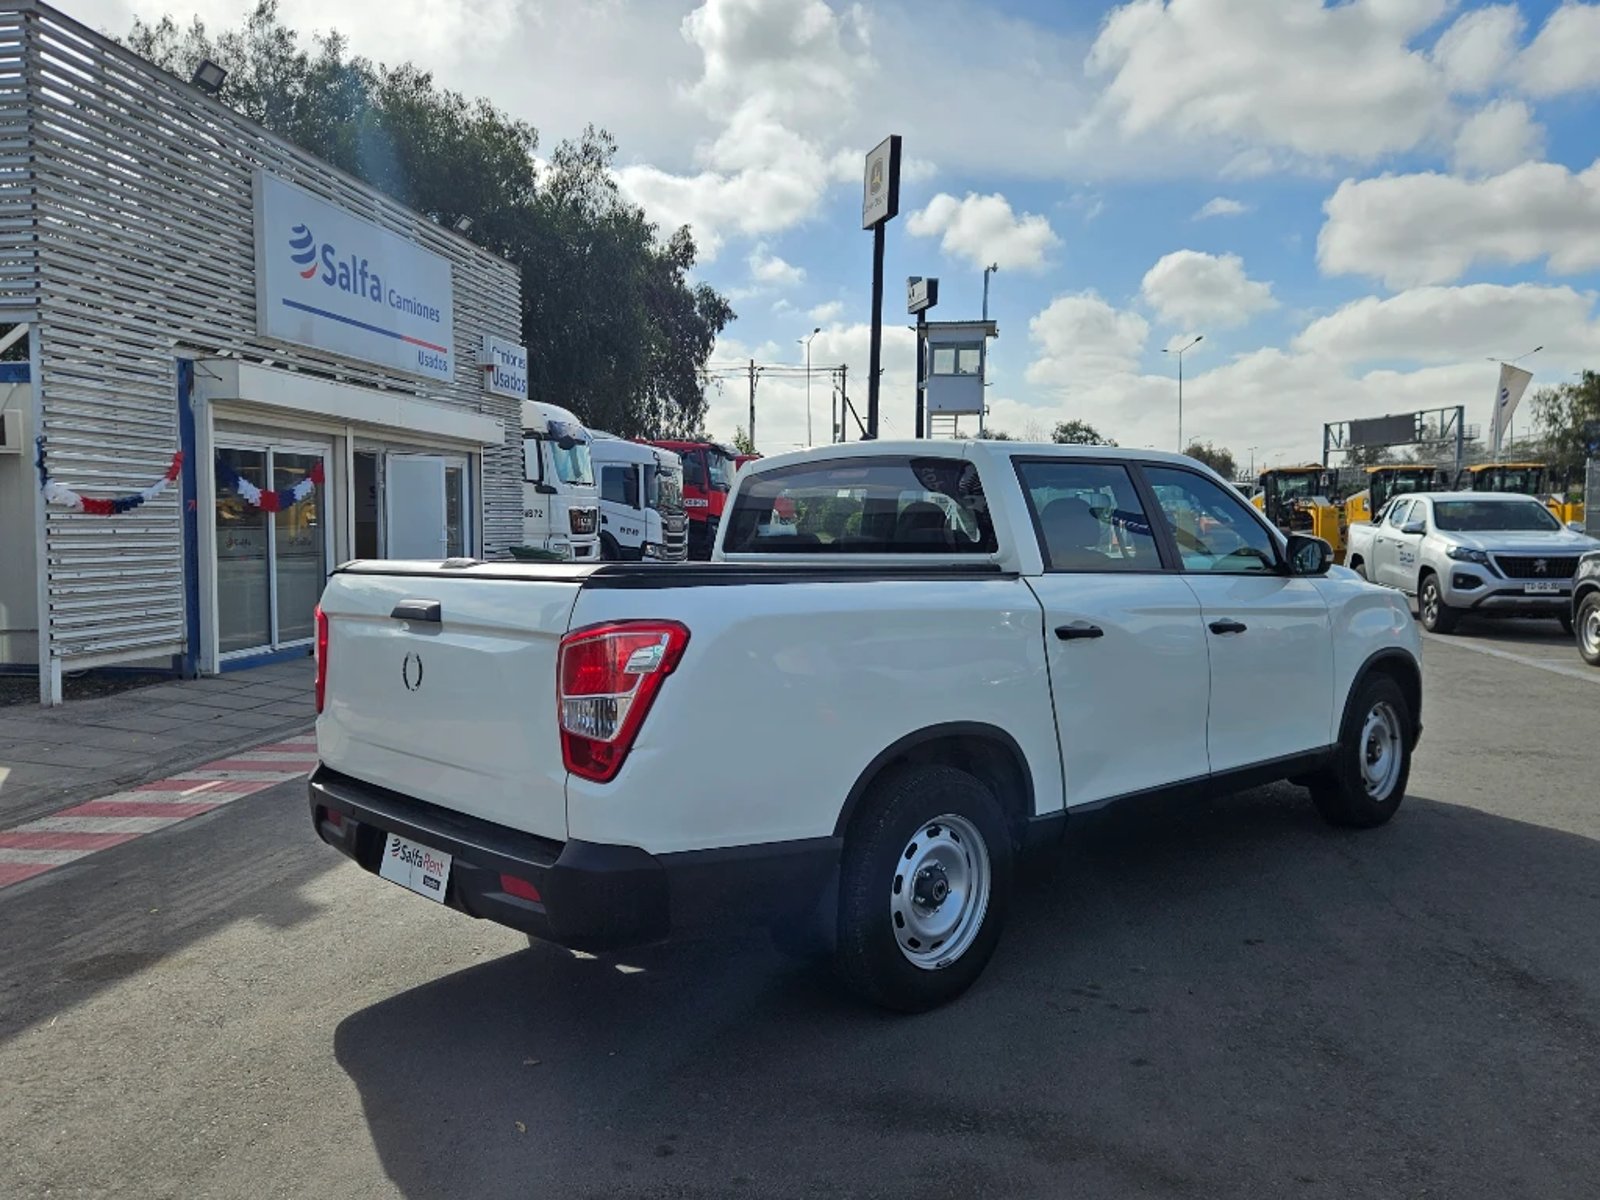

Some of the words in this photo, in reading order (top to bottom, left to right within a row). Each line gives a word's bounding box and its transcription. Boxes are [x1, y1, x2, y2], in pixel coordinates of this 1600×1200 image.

[321, 243, 382, 304] Salfa
[388, 290, 440, 323] Camiones
[418, 350, 448, 373] Usados
[492, 367, 526, 393] Usados
